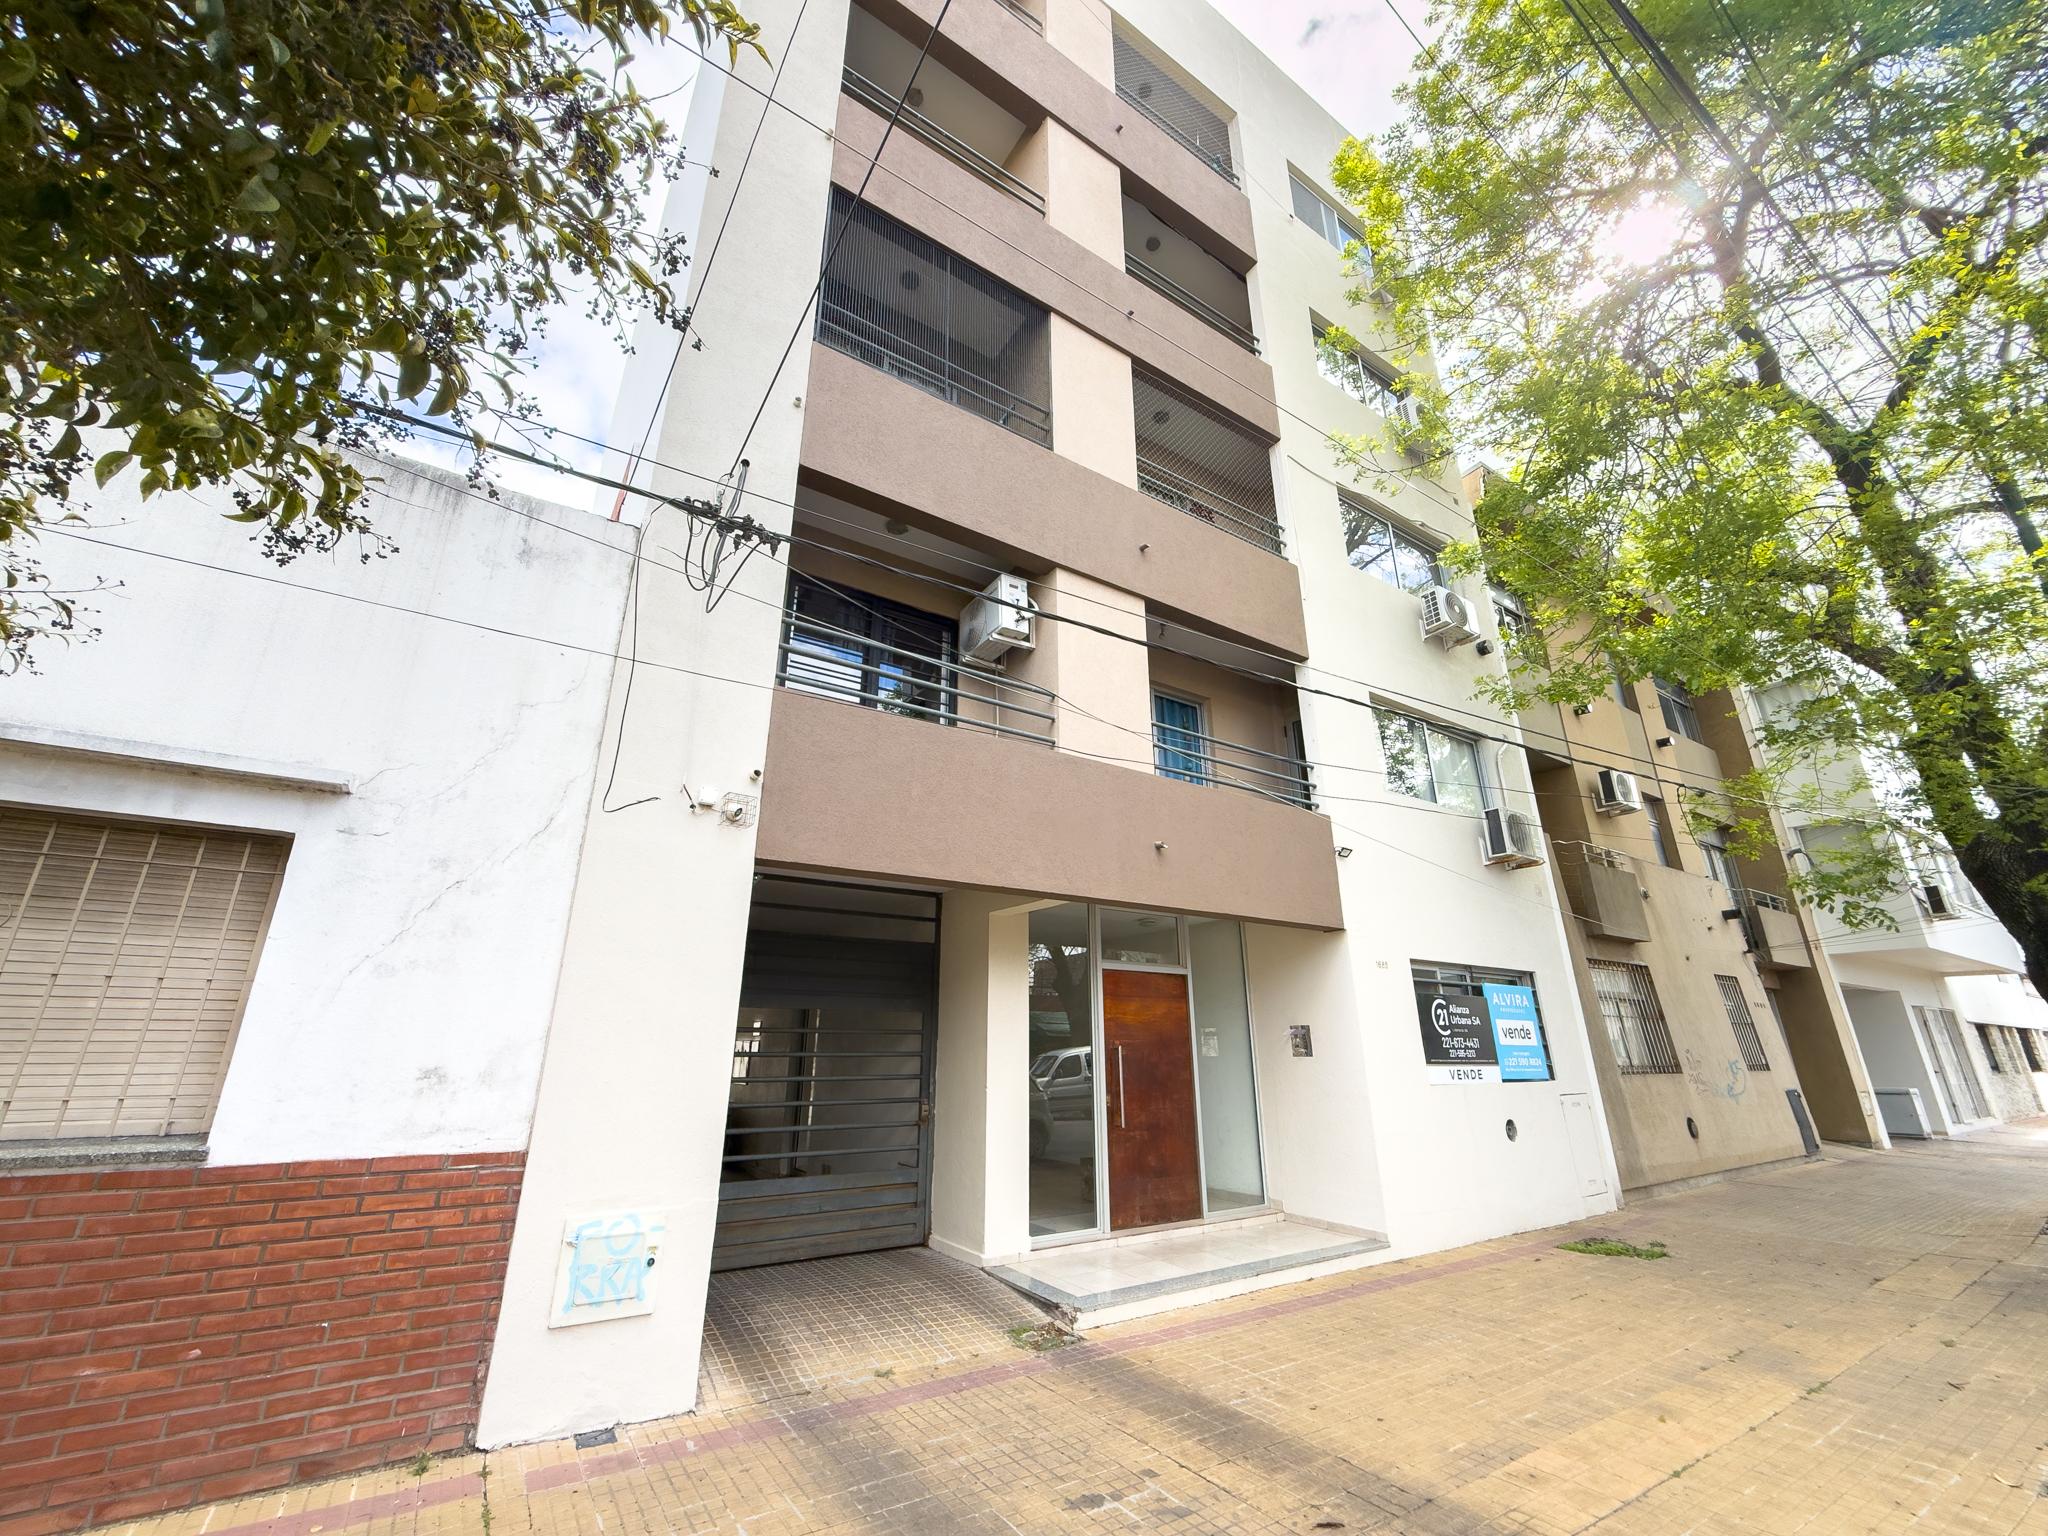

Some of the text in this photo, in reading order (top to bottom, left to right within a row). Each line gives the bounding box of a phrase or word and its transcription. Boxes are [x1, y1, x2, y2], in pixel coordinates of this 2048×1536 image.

[1493, 991, 1531, 1008] ALVIRA
[1449, 1004, 1470, 1014] Alianza
[1450, 1014, 1482, 1026] Urbana SA
[1501, 1024, 1533, 1040] vende
[1449, 1069, 1484, 1080] VENDE
